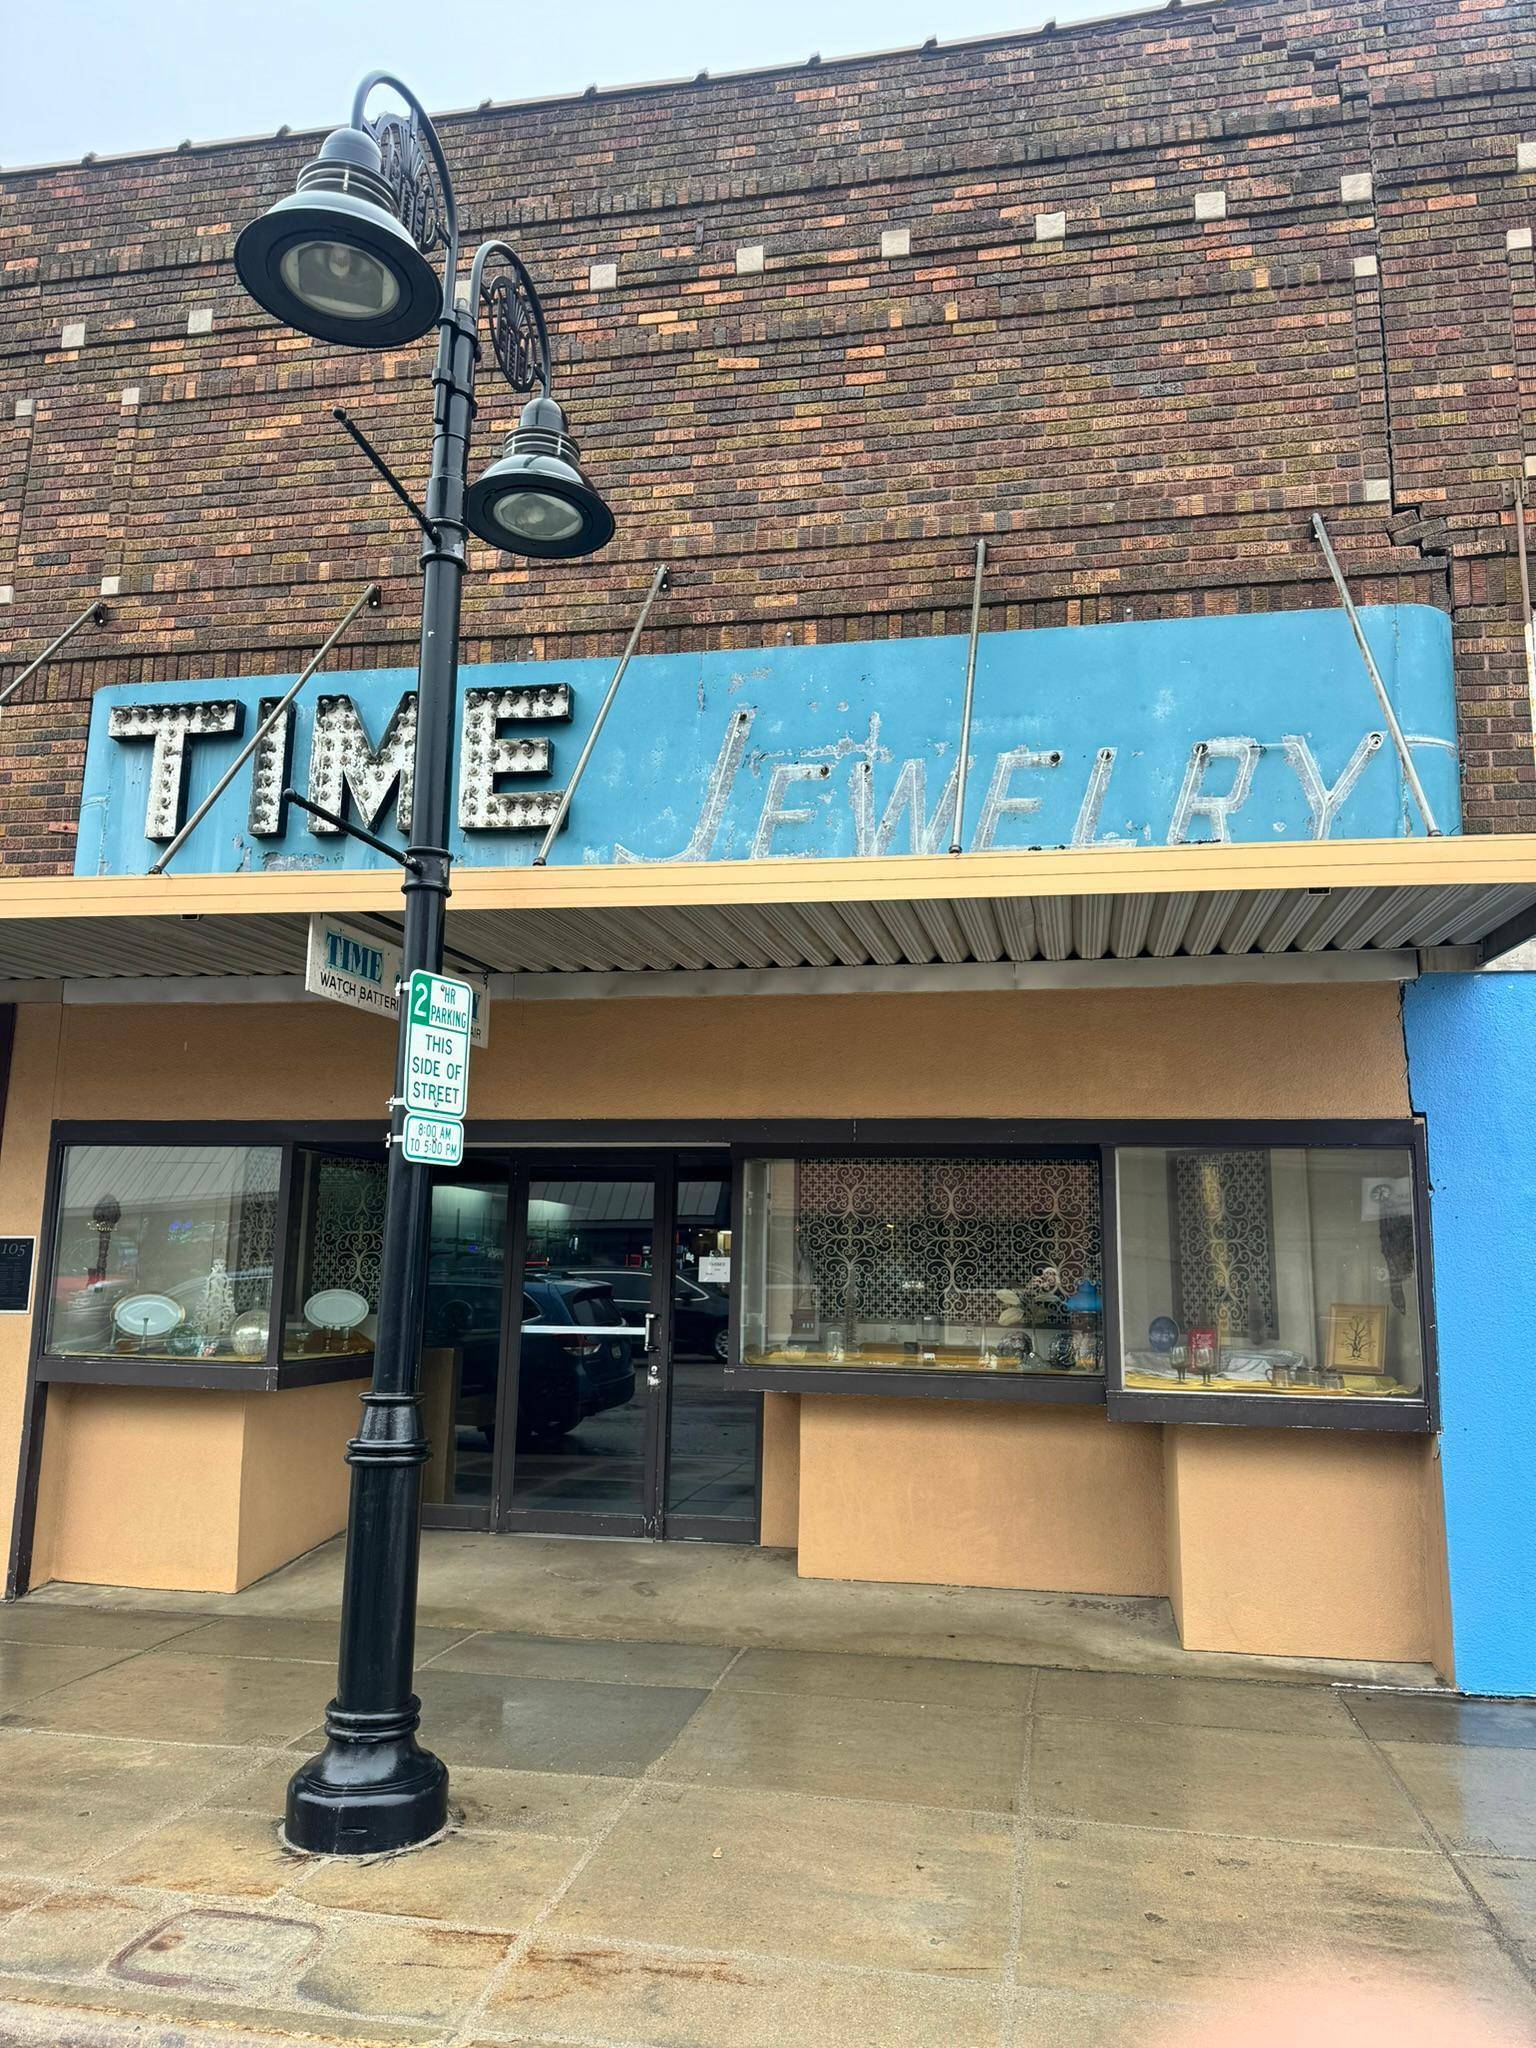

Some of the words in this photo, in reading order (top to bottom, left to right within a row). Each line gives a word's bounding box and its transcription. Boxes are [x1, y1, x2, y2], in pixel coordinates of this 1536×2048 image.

[108, 682, 575, 843] TIME
[613, 704, 1387, 864] JEWELRY
[326, 930, 384, 985] TIME
[320, 971, 356, 998] WATCH
[359, 985, 399, 1012] BATTERI
[414, 982, 428, 1018] 2
[444, 986, 457, 1006] HR
[431, 1004, 467, 1029] PARKING
[425, 1033, 453, 1056] THIS
[412, 1056, 441, 1078] SIDE
[446, 1062, 462, 1081] OF
[413, 1081, 460, 1105] STREET
[418, 1122, 437, 1138] 8:00
[440, 1126, 452, 1141] AM
[410, 1137, 420, 1152] TO
[424, 1139, 443, 1155] 5:00
[445, 1142, 457, 1157] PM
